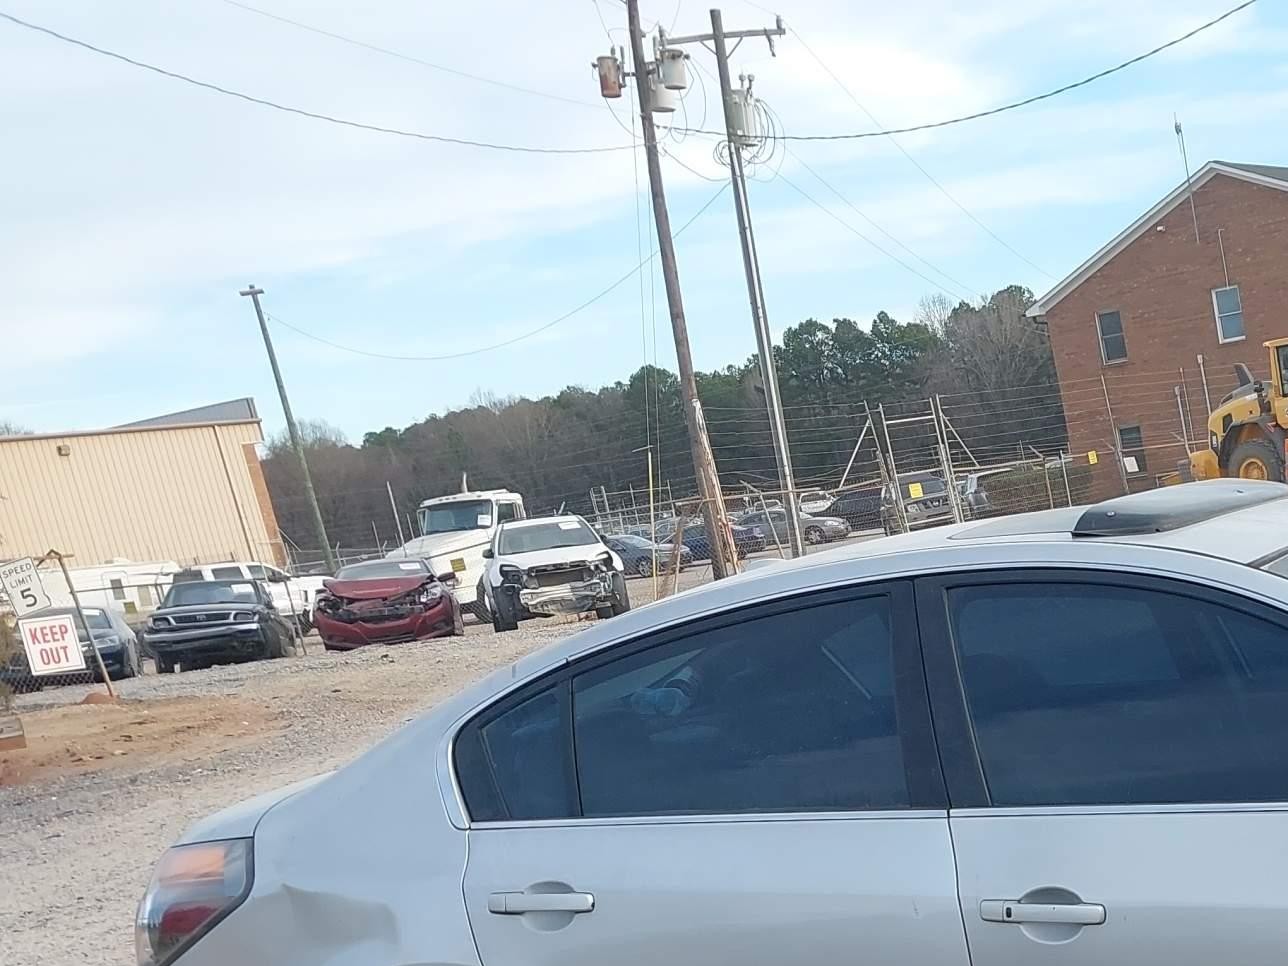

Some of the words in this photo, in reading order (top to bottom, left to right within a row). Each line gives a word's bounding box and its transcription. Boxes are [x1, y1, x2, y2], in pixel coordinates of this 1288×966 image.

[2, 563, 31, 578] SPEED
[10, 574, 32, 588] LIMIT
[20, 588, 37, 607] 5
[29, 624, 68, 645] KEEP
[40, 646, 70, 665] OUT
